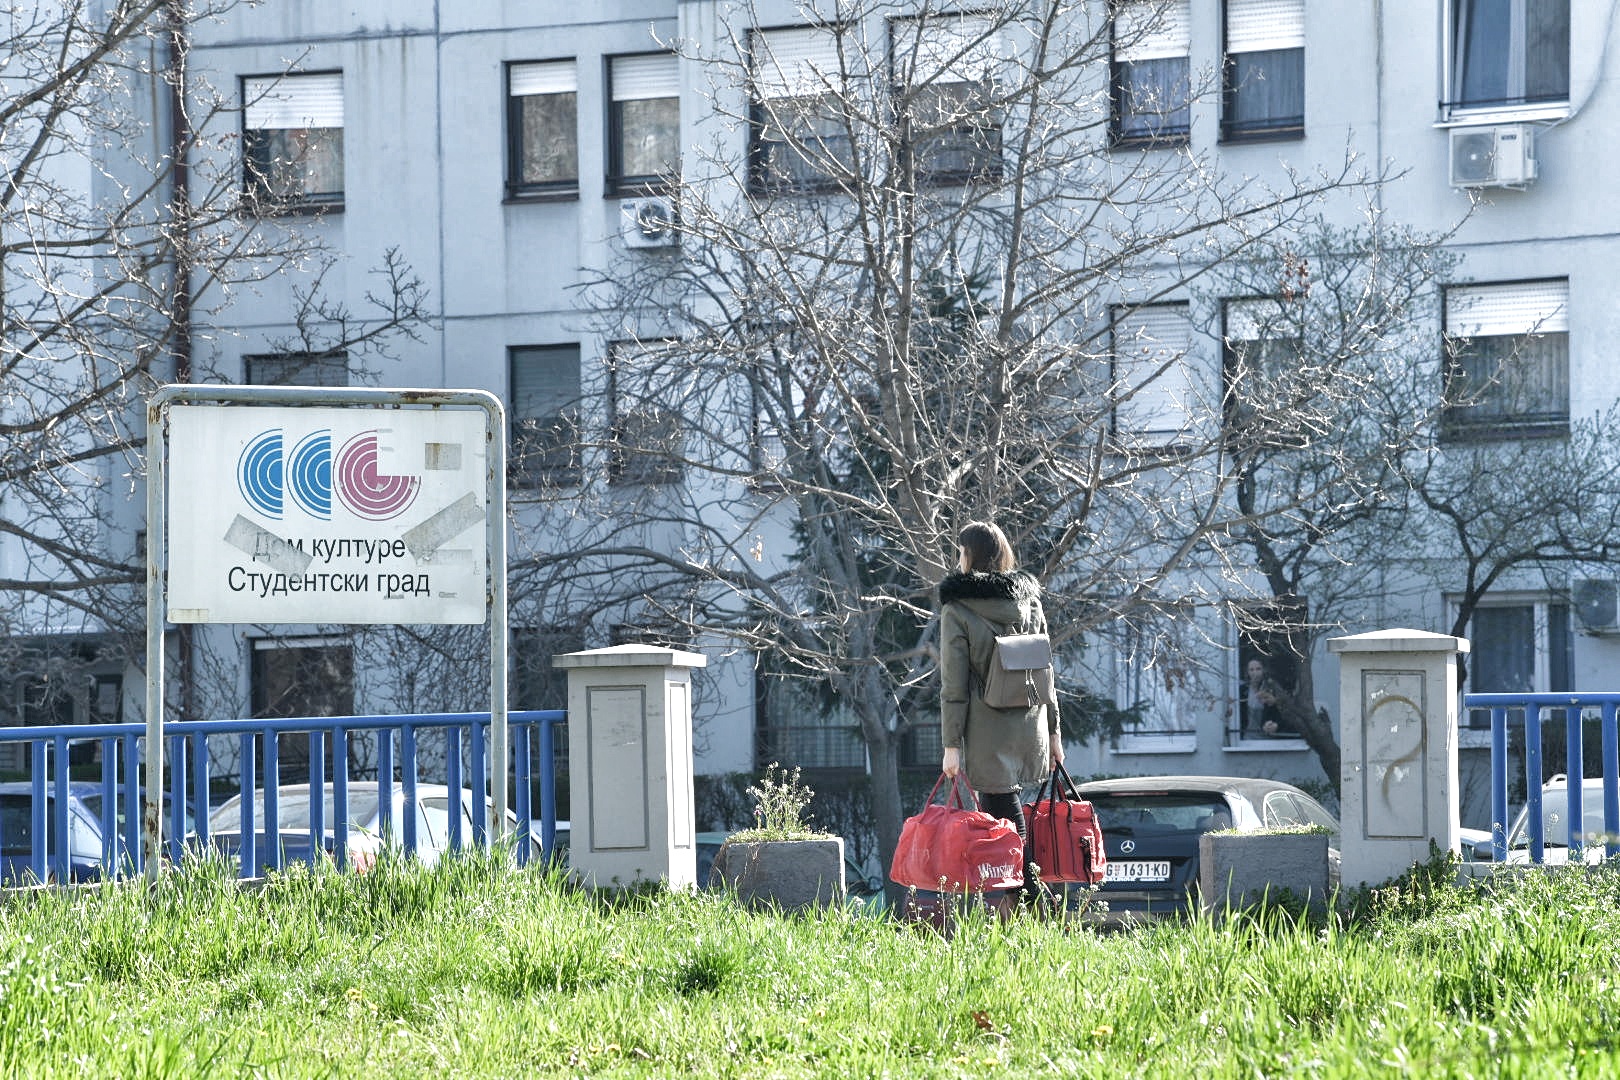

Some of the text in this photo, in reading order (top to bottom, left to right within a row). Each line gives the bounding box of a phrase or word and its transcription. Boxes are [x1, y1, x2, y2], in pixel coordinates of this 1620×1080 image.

[312, 538, 406, 564] културе
[228, 566, 431, 599] Студентски град
